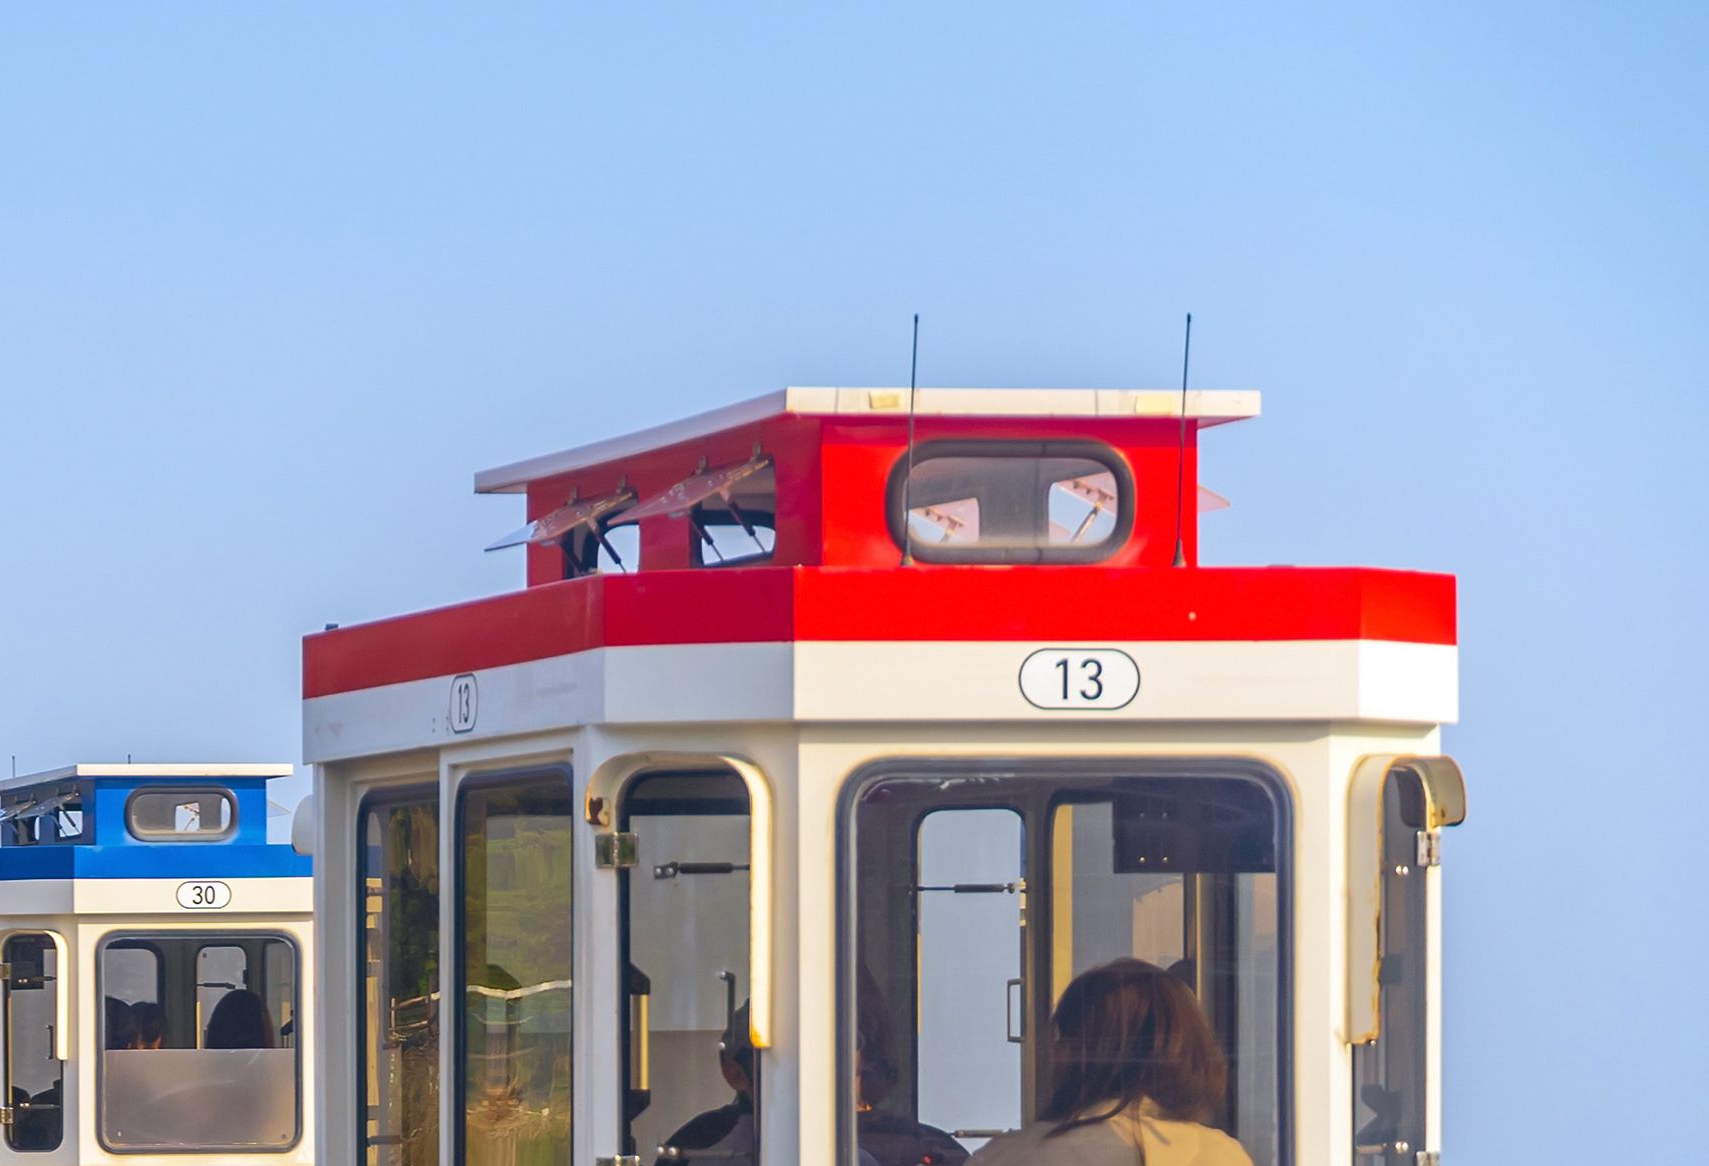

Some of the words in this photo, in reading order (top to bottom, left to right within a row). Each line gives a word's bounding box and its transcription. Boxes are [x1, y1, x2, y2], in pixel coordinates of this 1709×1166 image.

[1056, 658, 1103, 701] 13
[458, 683, 471, 724] 13
[192, 885, 216, 905] 30
